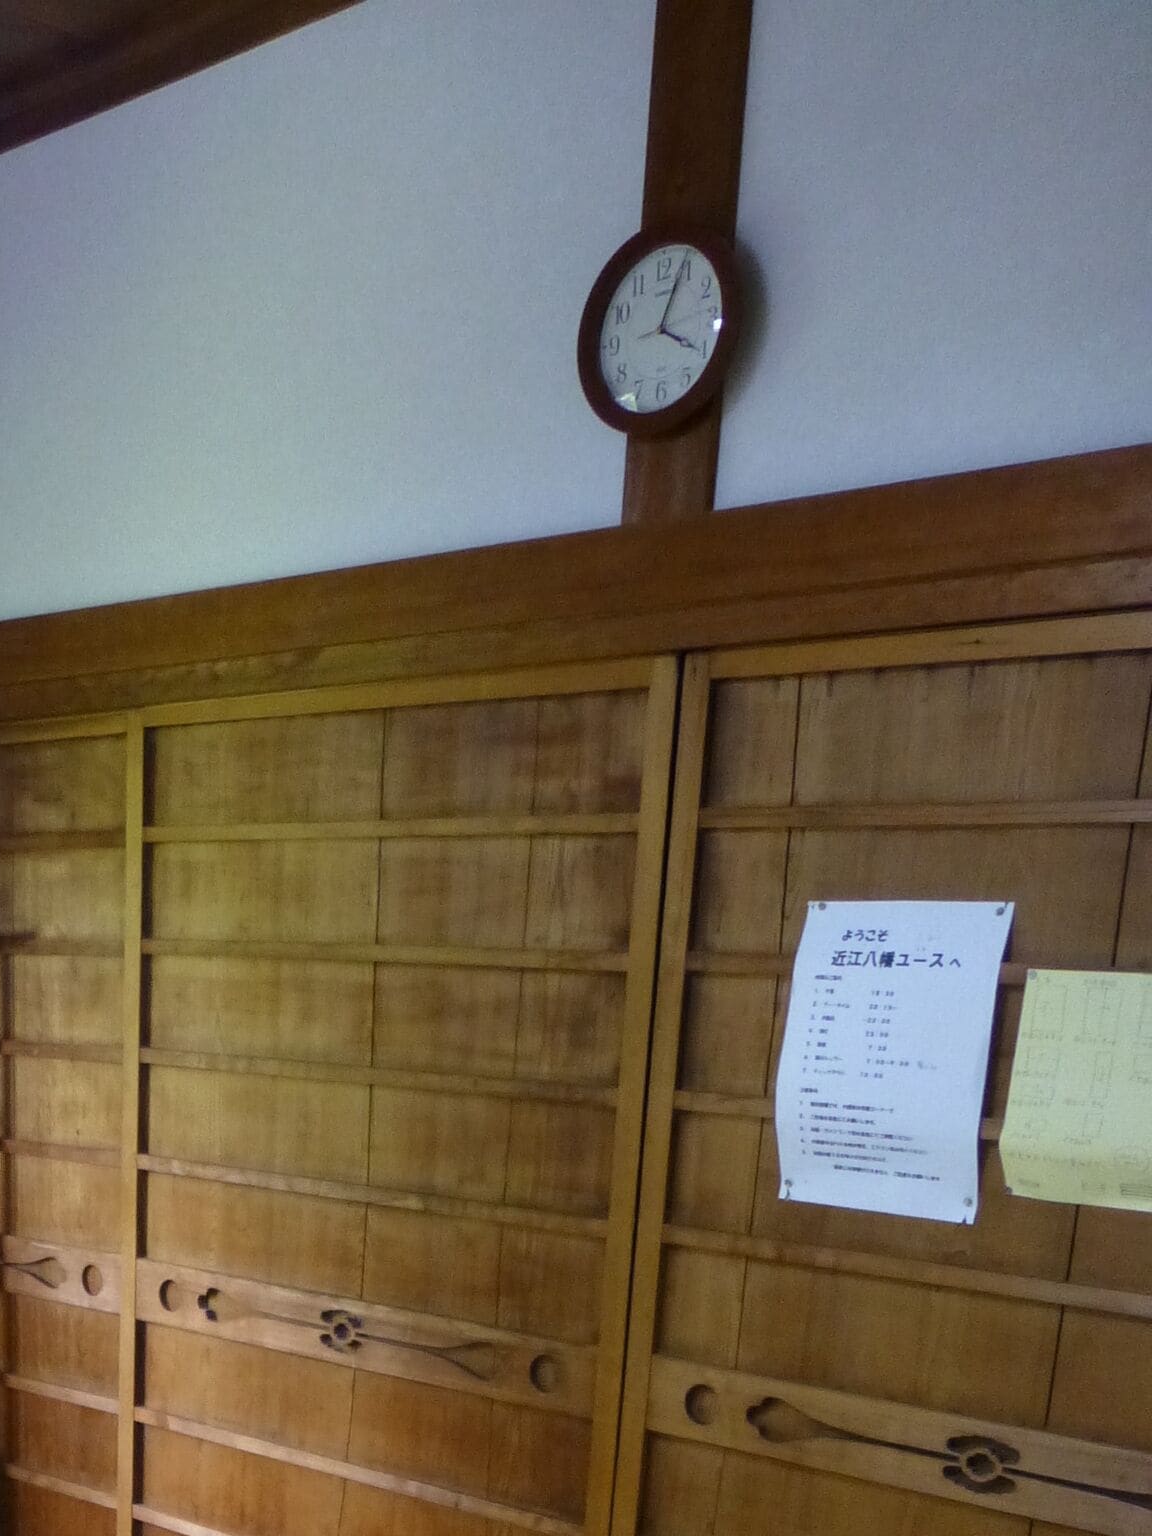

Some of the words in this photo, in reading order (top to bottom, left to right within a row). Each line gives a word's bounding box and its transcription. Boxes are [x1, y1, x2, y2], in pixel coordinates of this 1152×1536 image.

[656, 257, 672, 282] 12
[632, 274, 645, 298] 11
[701, 276, 711, 300] 2
[615, 302, 630, 325] 10
[609, 335, 620, 357] 9
[617, 363, 628, 384] 8
[679, 367, 692, 388] 5
[634, 379, 645, 401] 7
[656, 380, 667, 401] 6
[841, 929, 889, 942] ようこそ
